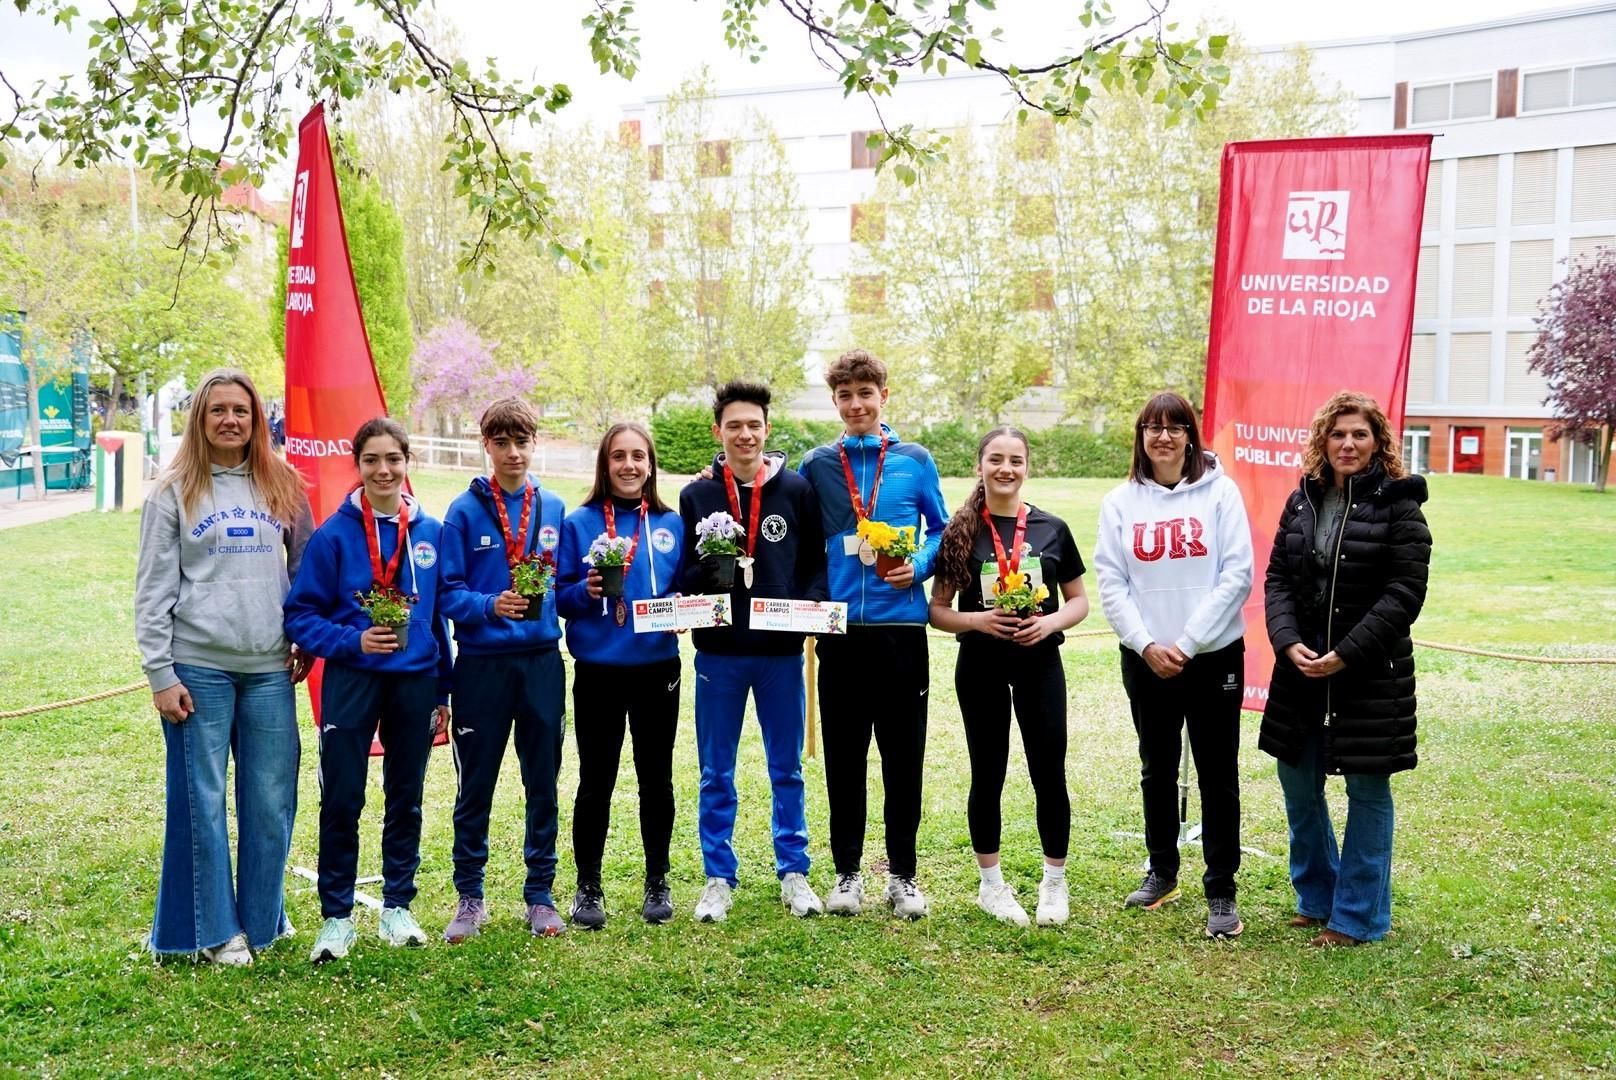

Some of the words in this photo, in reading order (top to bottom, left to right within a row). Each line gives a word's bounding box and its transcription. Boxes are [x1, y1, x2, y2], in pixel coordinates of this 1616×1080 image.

[1241, 274, 1390, 294] UNIVERSIDAD
[1247, 297, 1274, 315] DE
[1279, 298, 1307, 316] LA
[1313, 299, 1377, 321] RIOJA
[1235, 423, 1254, 440] TU
[1257, 426, 1311, 445] UNIVE
[1235, 445, 1303, 468] PÚBLICA
[192, 511, 230, 539] SANTA
[1133, 517, 1208, 562] UR
[648, 601, 673, 609] CARRERA
[648, 607, 674, 615] CAMPUS
